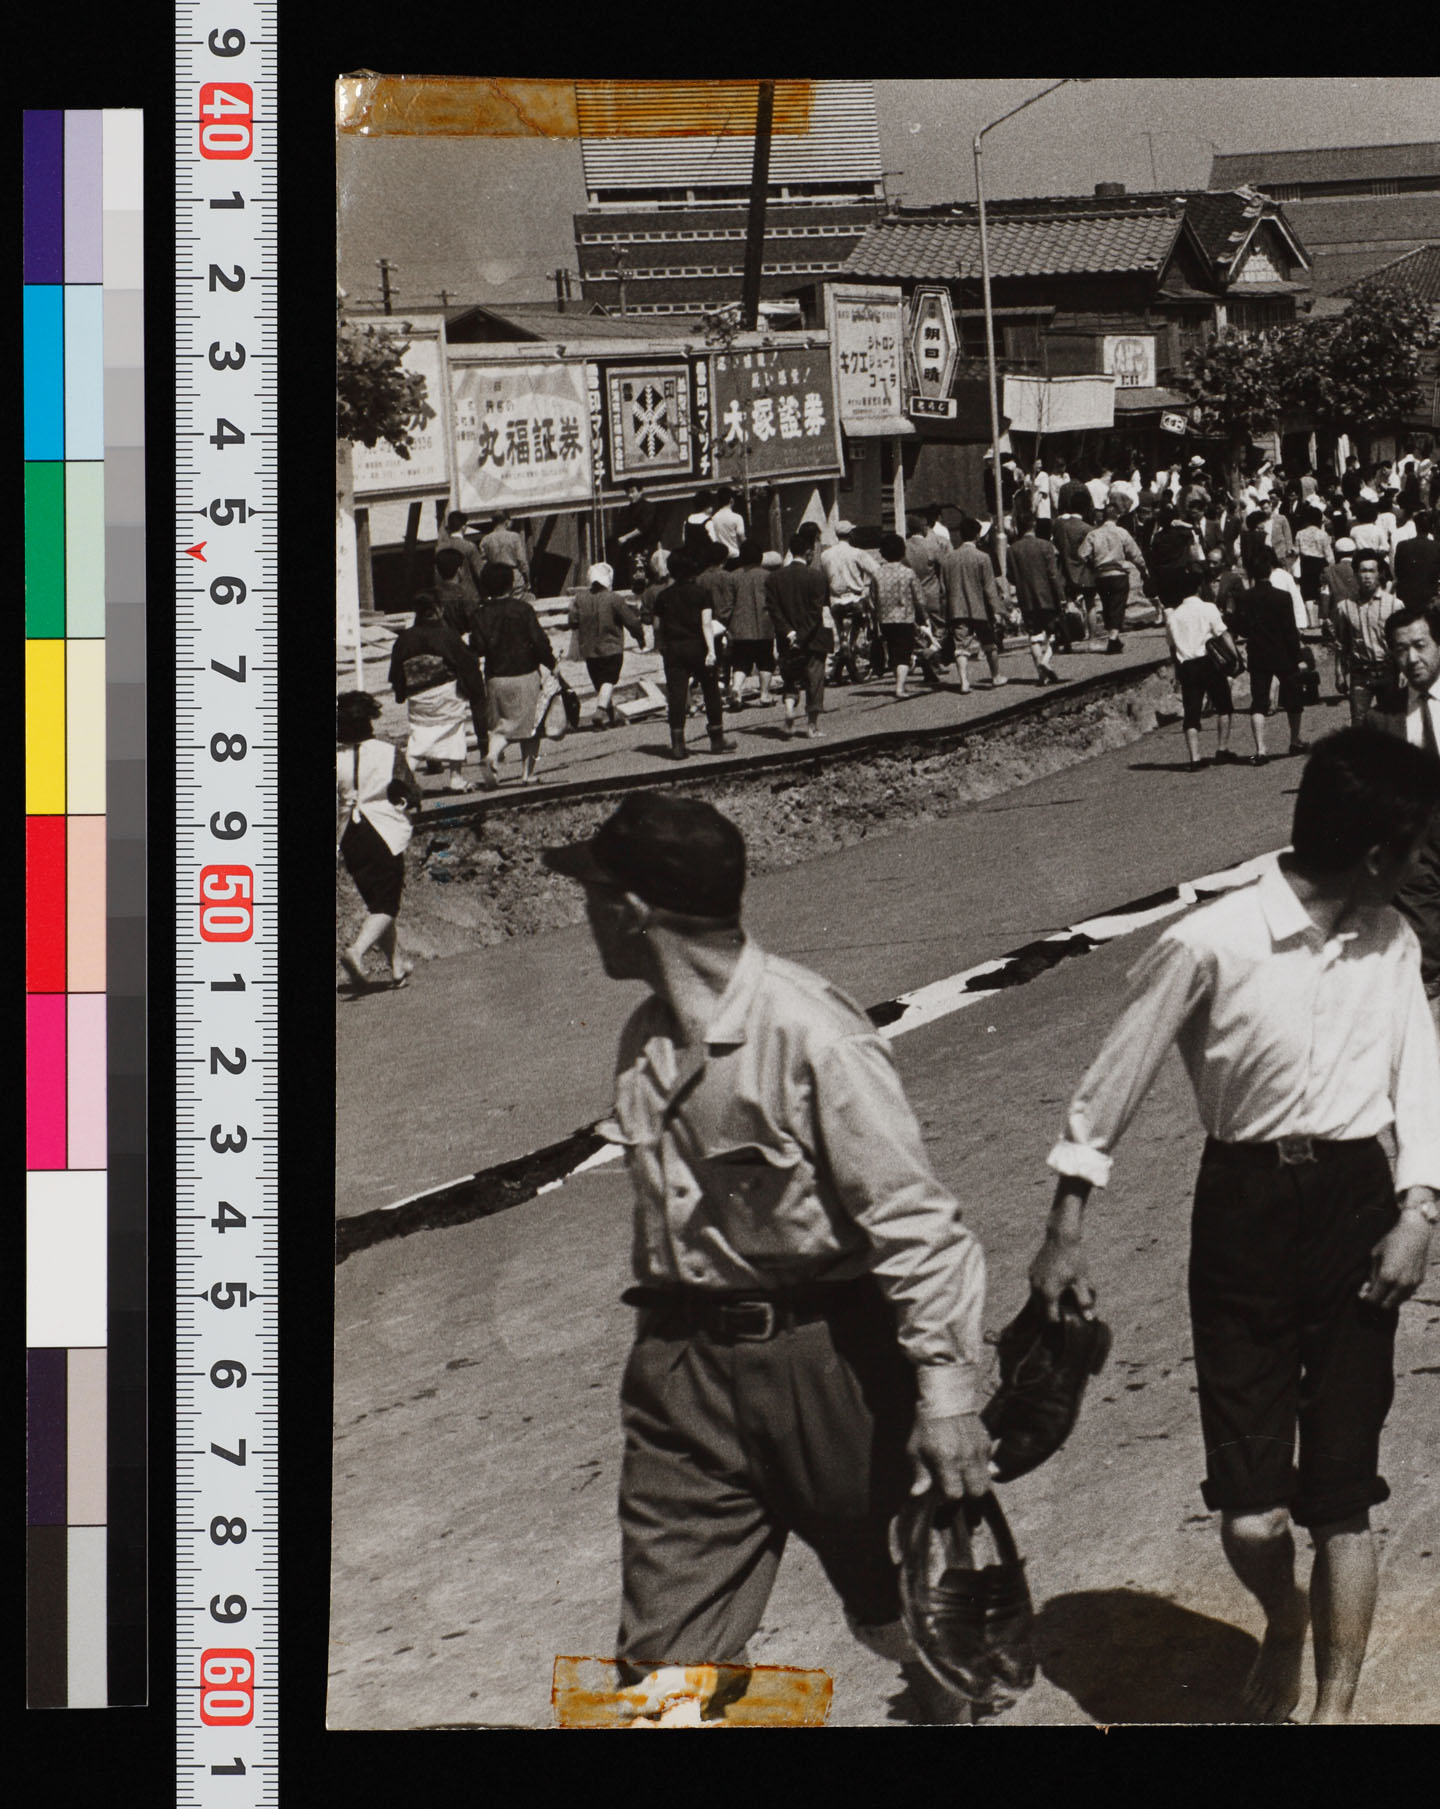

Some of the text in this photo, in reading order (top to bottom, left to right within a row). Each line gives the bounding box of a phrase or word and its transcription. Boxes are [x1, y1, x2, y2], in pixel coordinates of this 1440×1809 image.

[868, 336, 895, 350] シトロン
[924, 327, 941, 383] 朝日晴
[841, 352, 868, 374] キクエ
[870, 374, 896, 387] コーラ
[478, 416, 584, 468] 丸福証券
[203, 29, 251, 1775] 9 40 1 2 3 4 5 6 7 8 9 50 1 2 3 4 5 6 7 8 9 60 1
